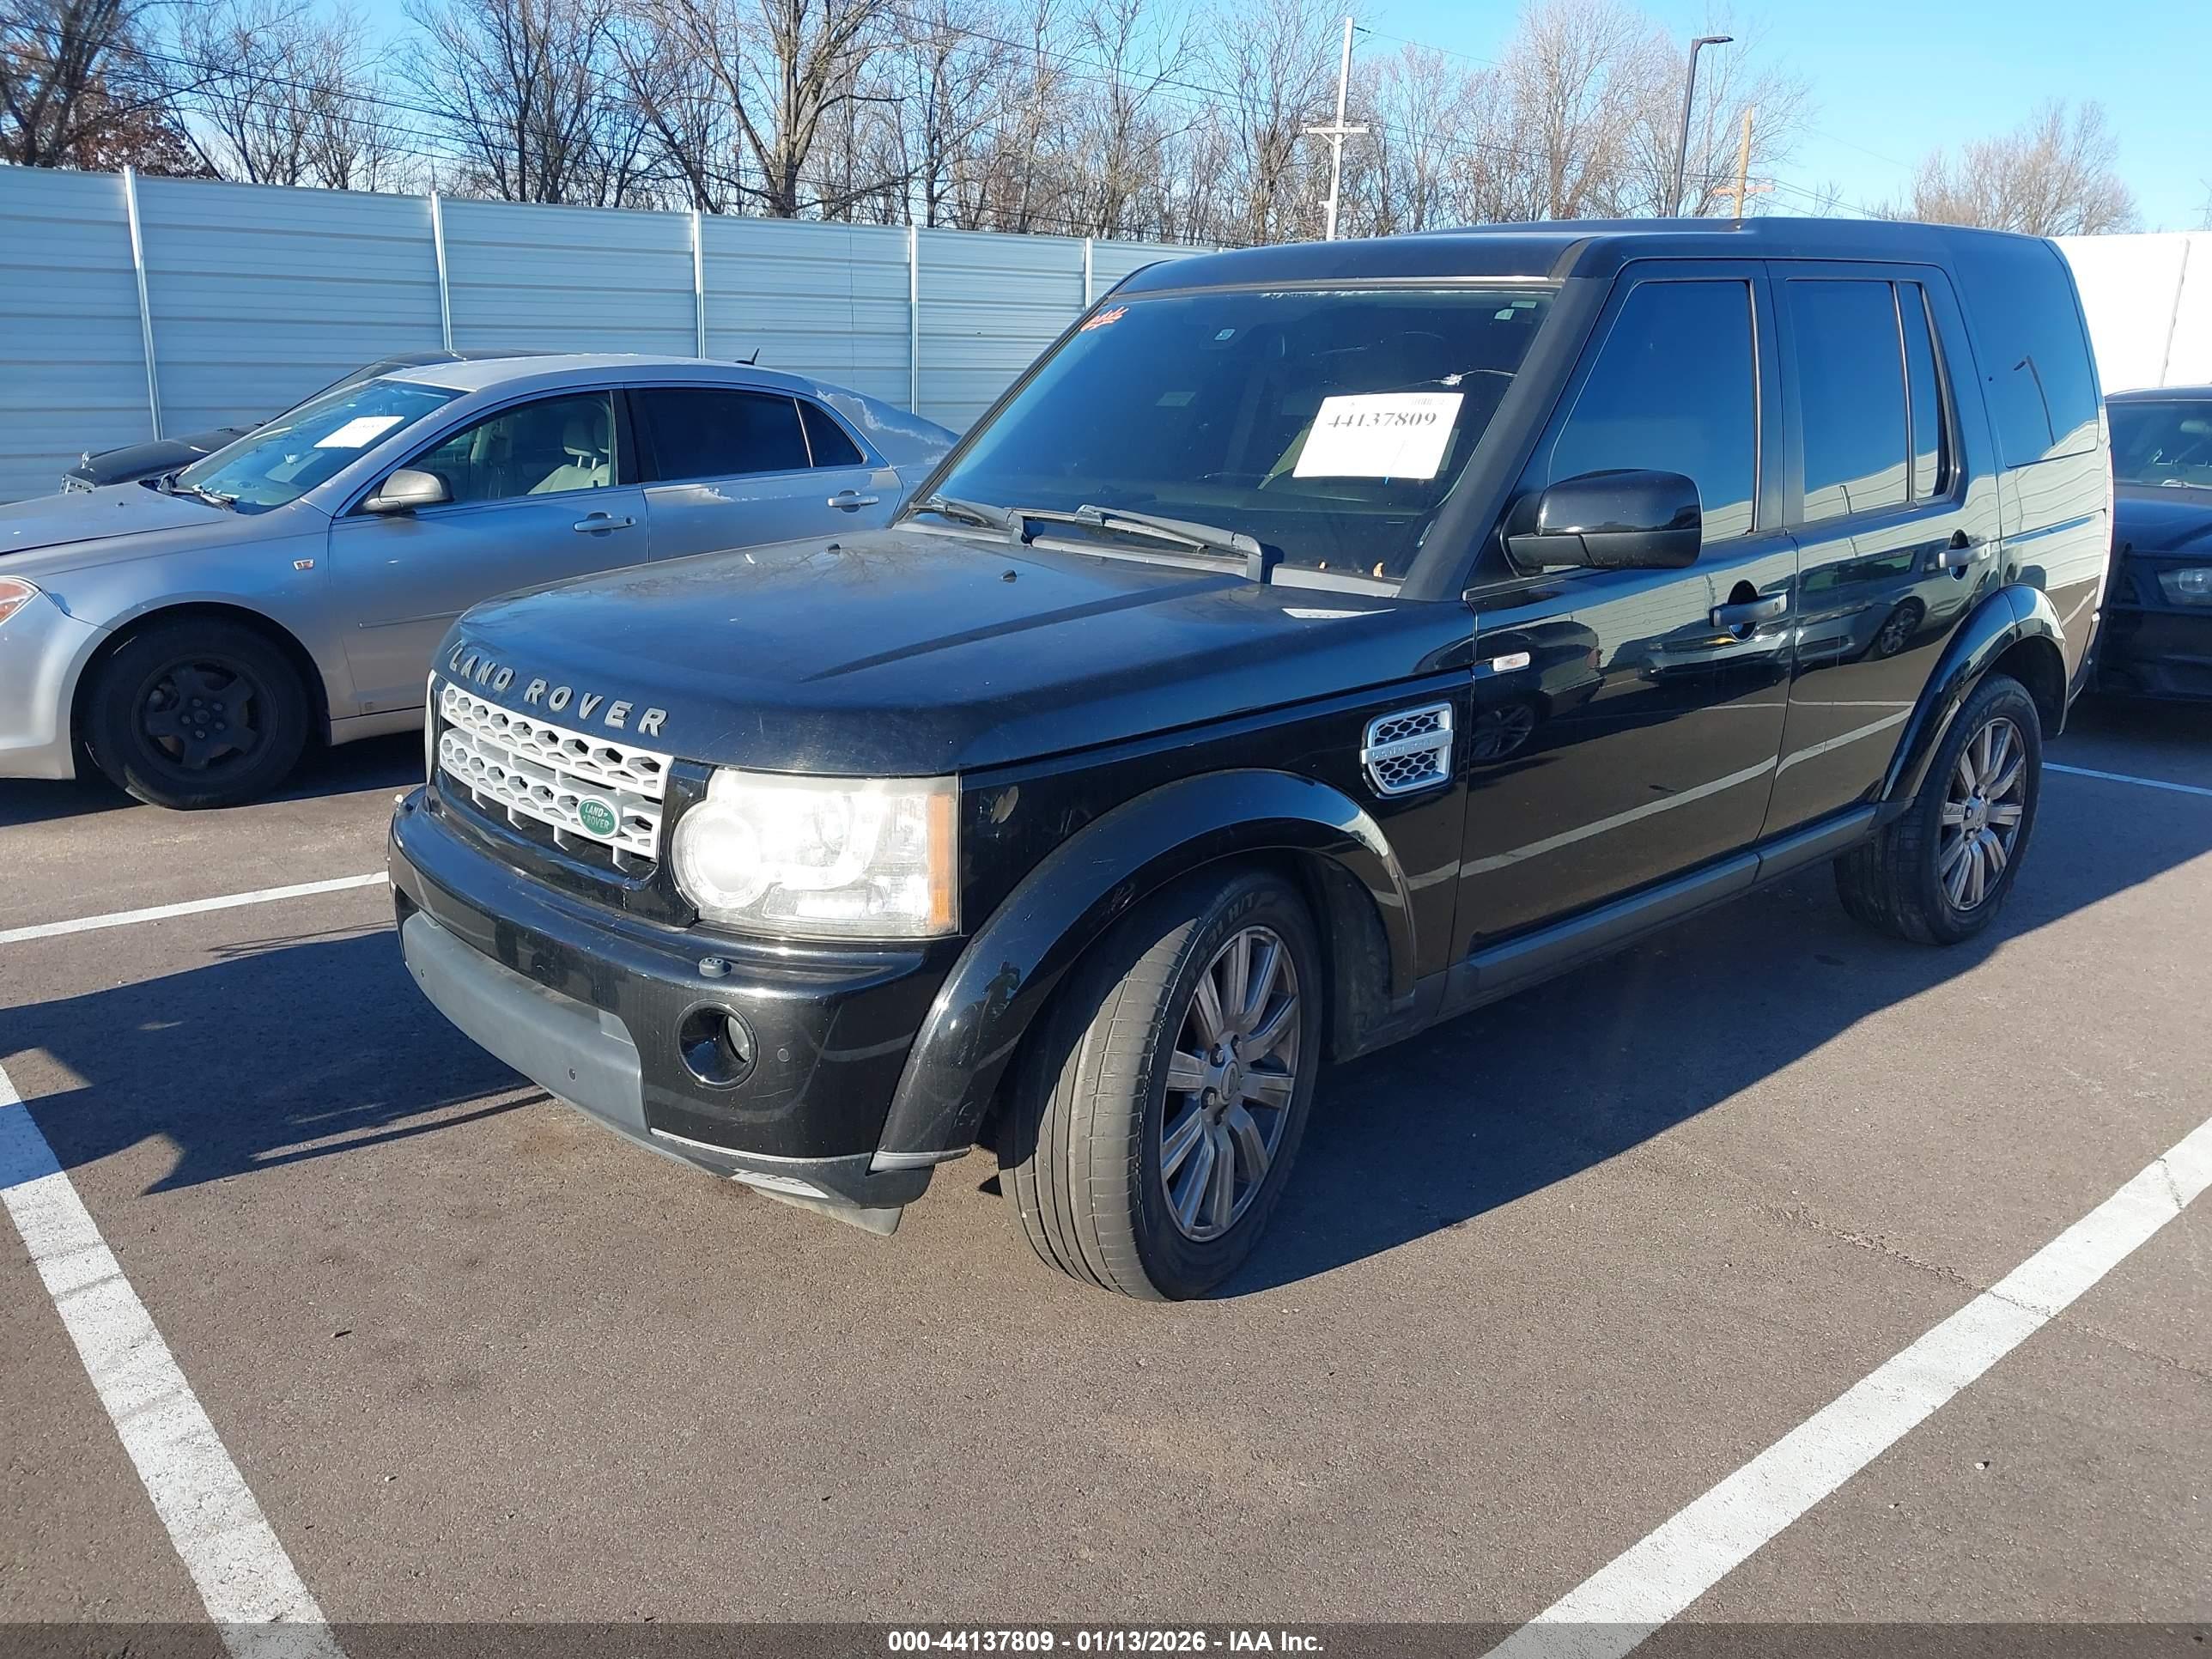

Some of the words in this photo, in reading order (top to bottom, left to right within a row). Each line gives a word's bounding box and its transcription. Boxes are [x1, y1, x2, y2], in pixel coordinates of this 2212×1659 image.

[1328, 411, 1437, 428] 44137809
[448, 647, 514, 692] LAND
[523, 678, 670, 738] ROVER
[585, 803, 604, 817] LAND
[586, 814, 610, 830] ROVER
